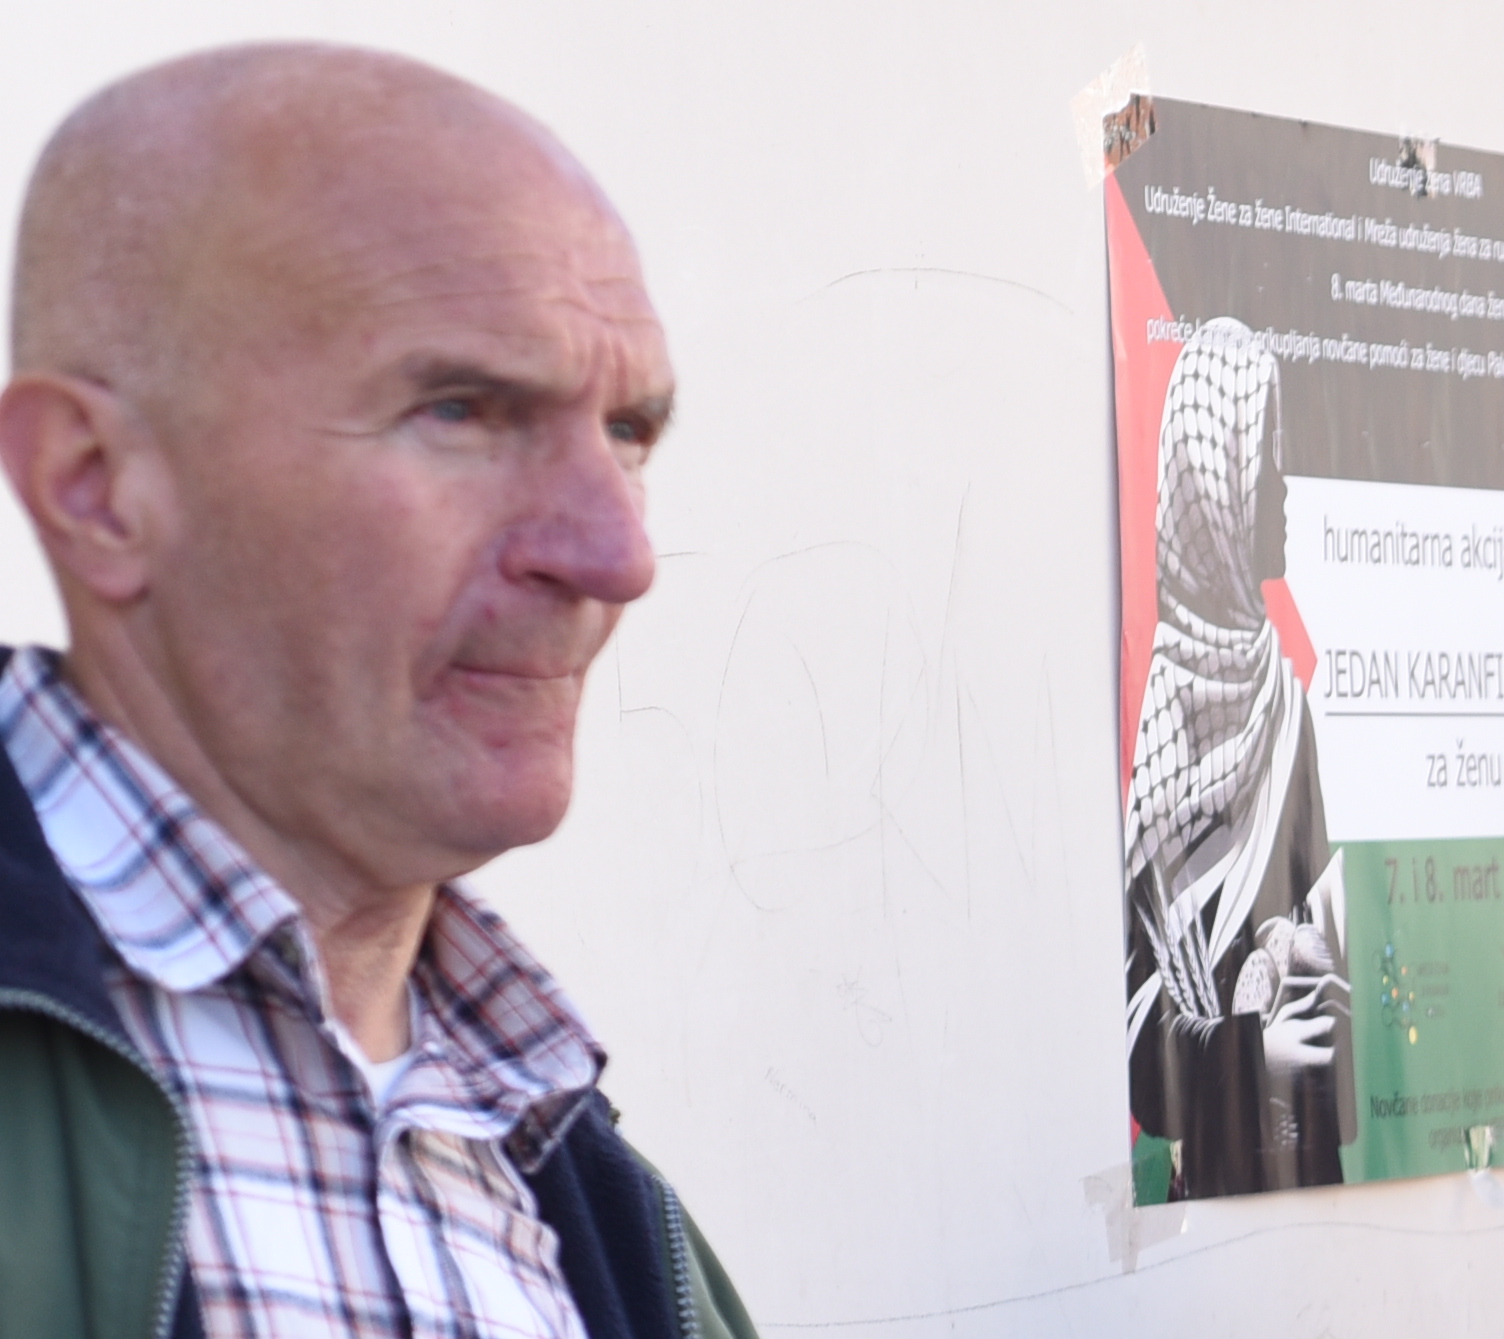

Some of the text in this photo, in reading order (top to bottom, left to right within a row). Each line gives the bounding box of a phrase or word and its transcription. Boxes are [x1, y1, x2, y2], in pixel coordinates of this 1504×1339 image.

[1144, 185, 1205, 226] Udruženje
[1207, 186, 1237, 226] Žene
[1239, 203, 1253, 228] za
[1255, 198, 1285, 232] žene
[1285, 204, 1356, 242] International
[1365, 217, 1398, 248] Mreža
[1331, 272, 1344, 301] 8.
[1345, 278, 1378, 306] marta
[1147, 314, 1193, 345] pokreće
[1322, 514, 1453, 569] humanitarna
[1323, 648, 1400, 701] JEDAN
[1426, 750, 1449, 788] za
[1455, 738, 1502, 788] ženu
[1385, 858, 1405, 905] 7.
[1412, 858, 1420, 901] i
[1426, 857, 1446, 901] 8.
[1453, 858, 1501, 900] mart
